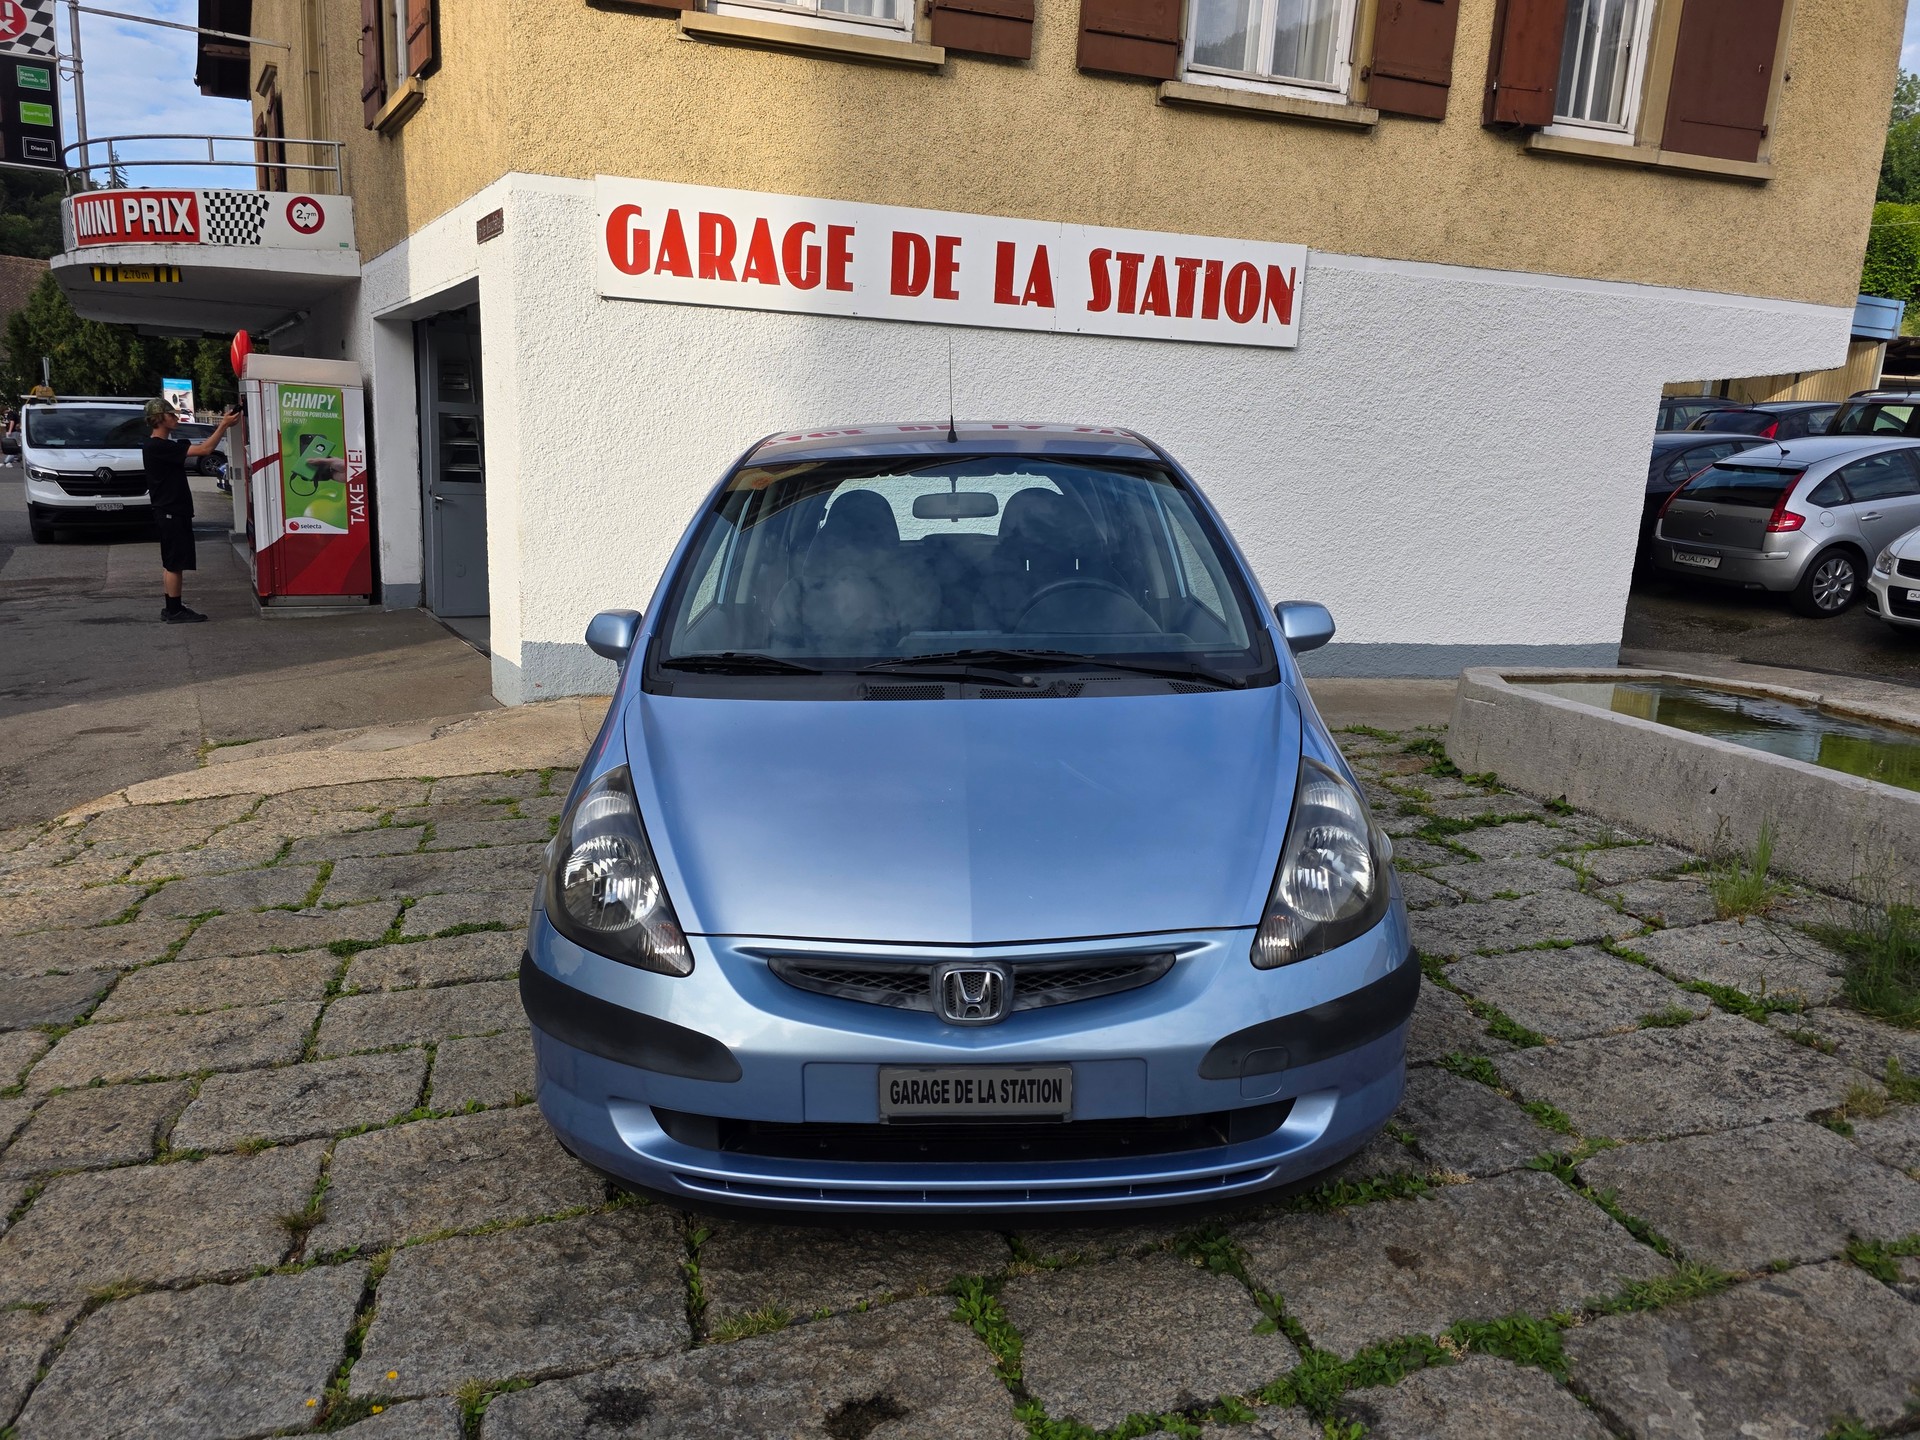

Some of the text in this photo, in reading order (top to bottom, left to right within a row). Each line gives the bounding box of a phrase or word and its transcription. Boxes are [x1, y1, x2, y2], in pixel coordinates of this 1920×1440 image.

[78, 197, 196, 237] MINI PRIX
[605, 203, 1297, 326] GARAGE DE LA STATION
[282, 392, 336, 410] CHIMPY
[348, 450, 365, 526] TAKE ME!
[1679, 553, 1712, 565] QUALITY
[890, 1078, 1062, 1104] GARAGE DE LA STATION
